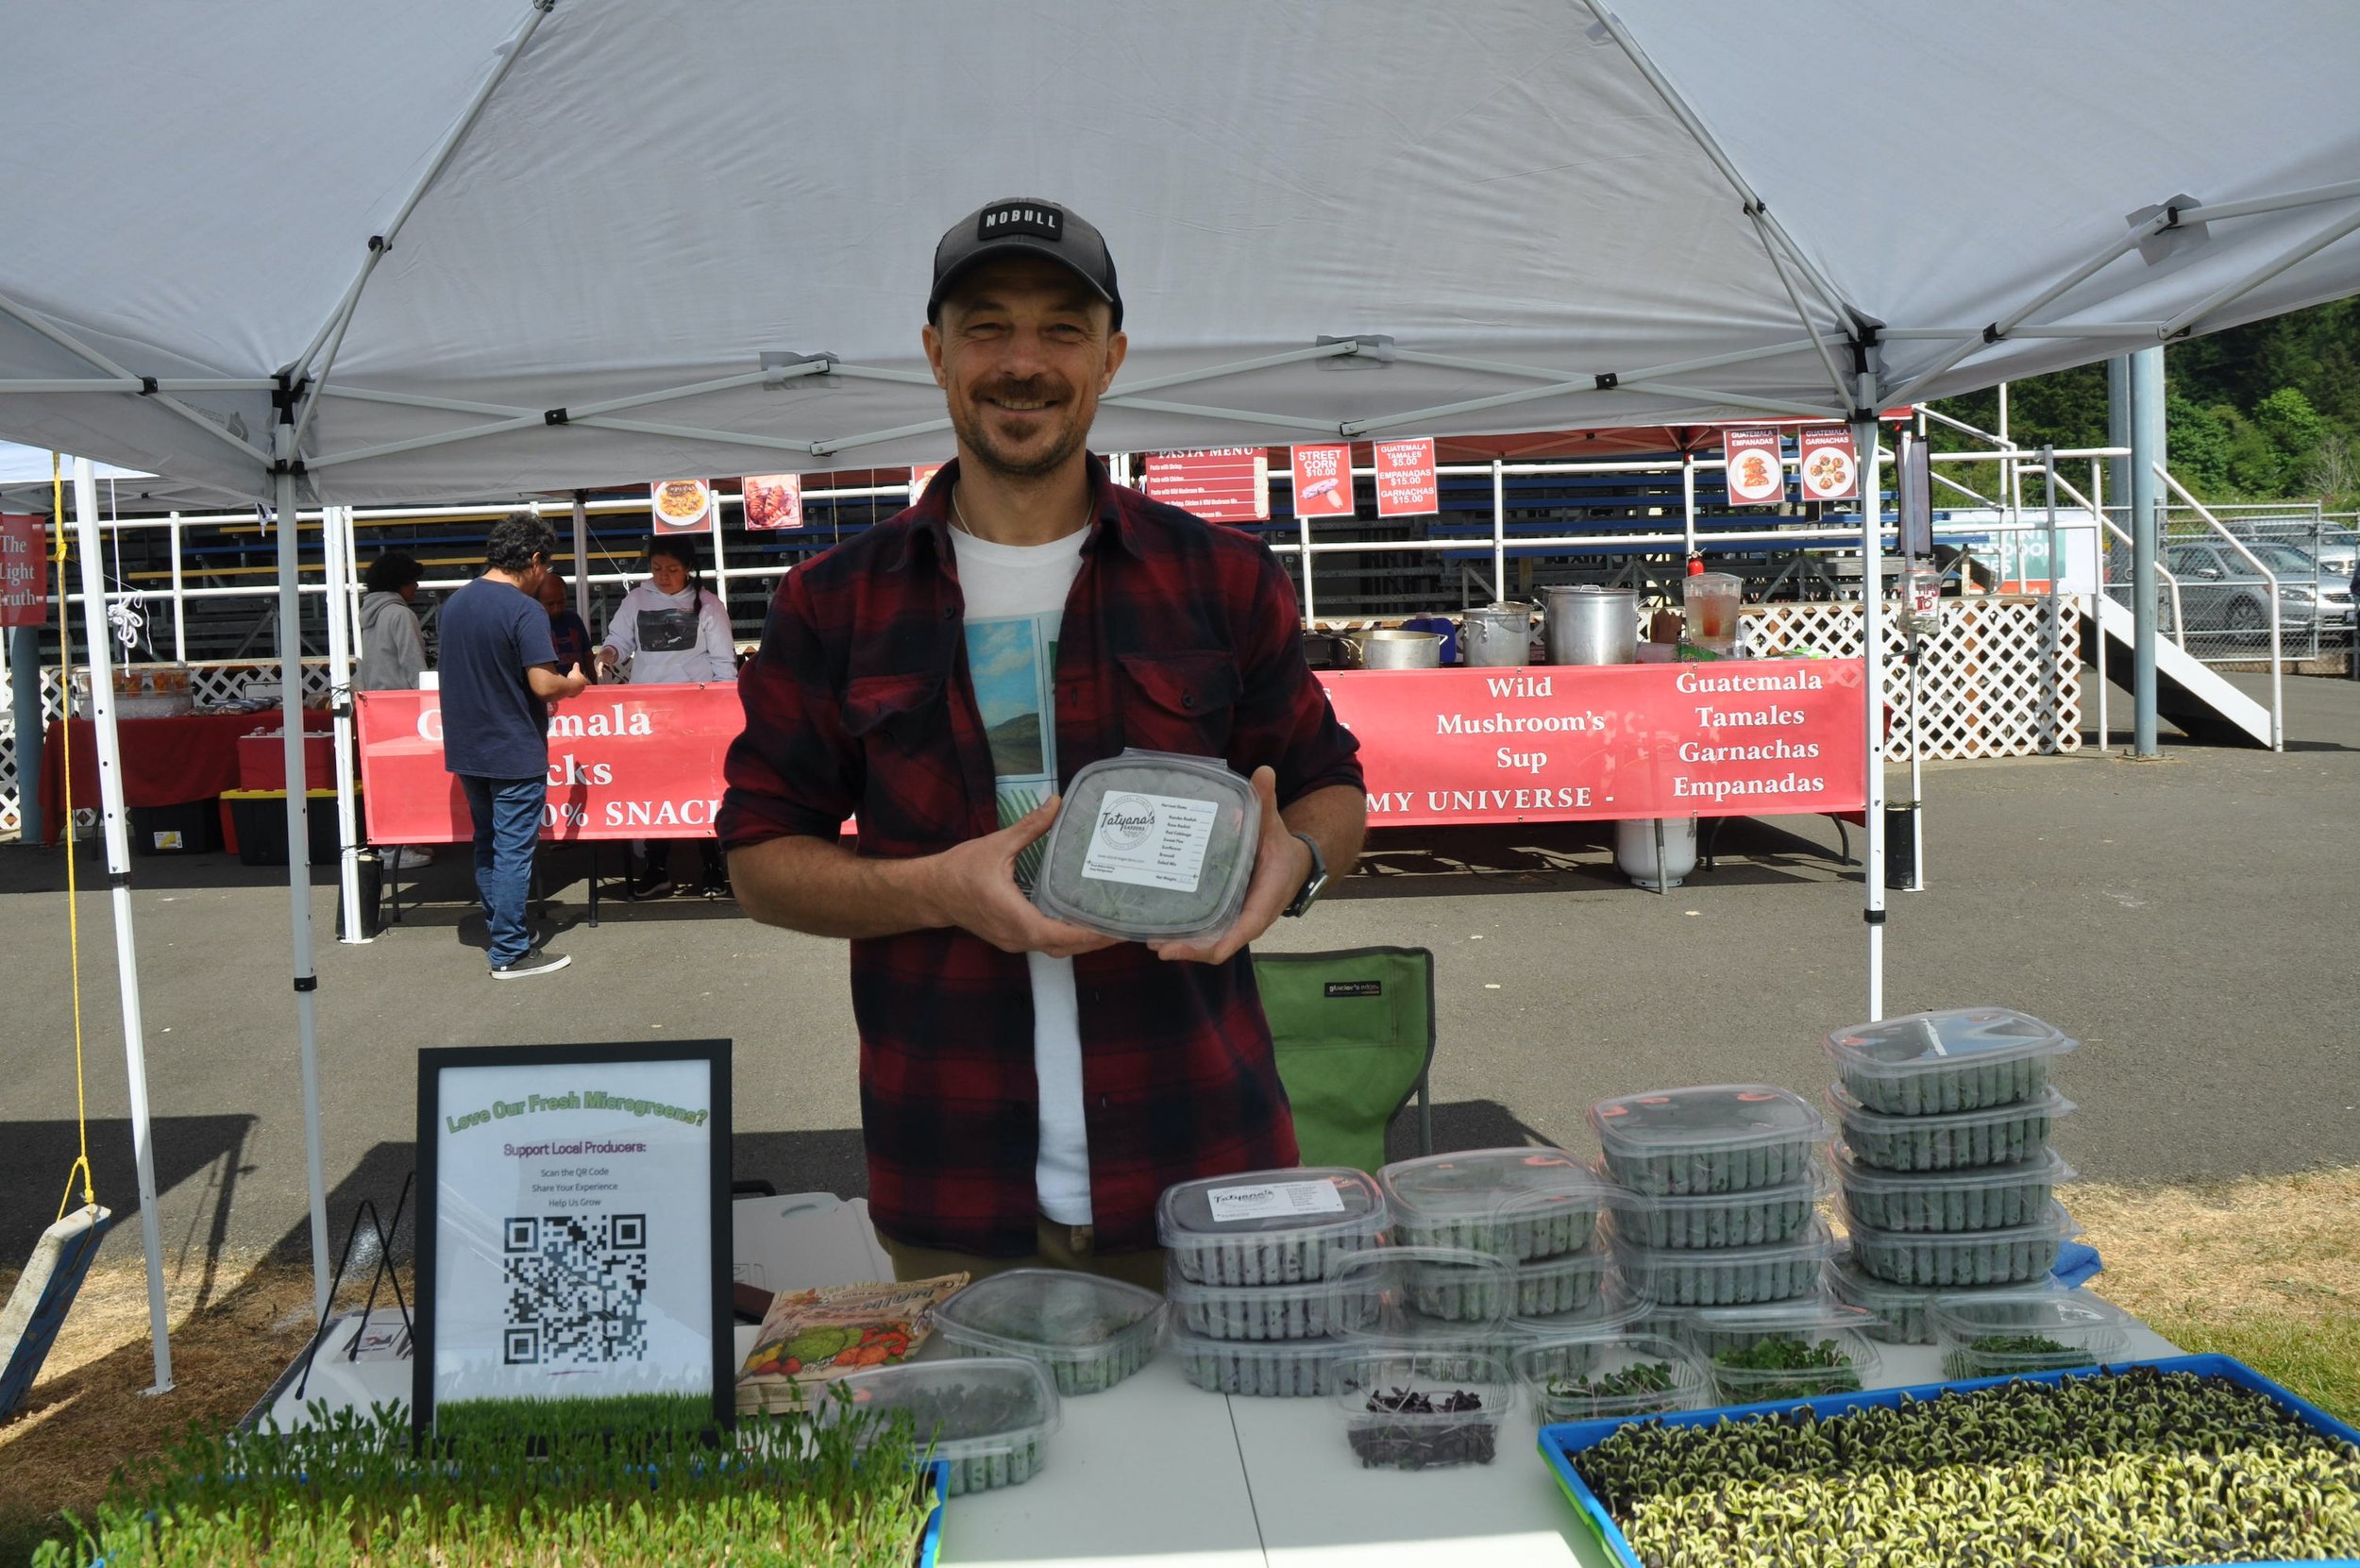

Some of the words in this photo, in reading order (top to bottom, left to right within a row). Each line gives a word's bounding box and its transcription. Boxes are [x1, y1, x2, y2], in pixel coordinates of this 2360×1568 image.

[986, 210, 1055, 228] NOBULL
[1731, 430, 1774, 439] GUATEMALA
[1805, 429, 1848, 437] GUATEMALA
[1731, 437, 1774, 447] EMPANADAS
[1805, 437, 1849, 446] GARNACHAS
[1209, 447, 1254, 457] MENU
[1381, 444, 1427, 453] GUATEMALA
[1298, 449, 1342, 462] STREET
[1387, 451, 1422, 461] TAMALES
[1304, 460, 1337, 470] CORN
[1392, 458, 1417, 467] $5.00
[1306, 468, 1337, 478] $10.00
[1379, 469, 1431, 480] EMPANADAS
[1391, 478, 1421, 486] $15.00
[1380, 487, 1435, 498] GARNACHAS
[1392, 495, 1424, 505] $15.00
[0, 535, 27, 553] The
[0, 562, 35, 586] Light
[1676, 669, 1823, 694] Guatemala
[1486, 676, 1553, 699] Wild
[1694, 704, 1805, 728] Tamales
[1436, 710, 1606, 735] Mushroom's
[1678, 738, 1819, 763] Garnachas
[1496, 746, 1548, 773] Sup
[1673, 772, 1825, 802] Empanadas
[1365, 791, 1414, 813] MY
[1426, 787, 1593, 812] UNIVERSE
[1101, 810, 1155, 831] Tatyana's
[446, 1108, 492, 1134] Love
[492, 1099, 526, 1120] Our
[528, 1091, 581, 1113] Fresh
[583, 1091, 708, 1128] Microgreens?
[503, 1142, 550, 1158] Support
[552, 1140, 582, 1155] Local
[584, 1140, 647, 1155] Producers:
[540, 1169, 560, 1177] Scan
[561, 1168, 574, 1176] the
[575, 1168, 587, 1177] QR
[588, 1167, 609, 1176] Code
[531, 1184, 555, 1192] Share
[555, 1183, 574, 1192] Your
[575, 1182, 618, 1193] Experience
[548, 1198, 567, 1208] Help
[568, 1198, 579, 1207] Us
[580, 1197, 601, 1206] Grow
